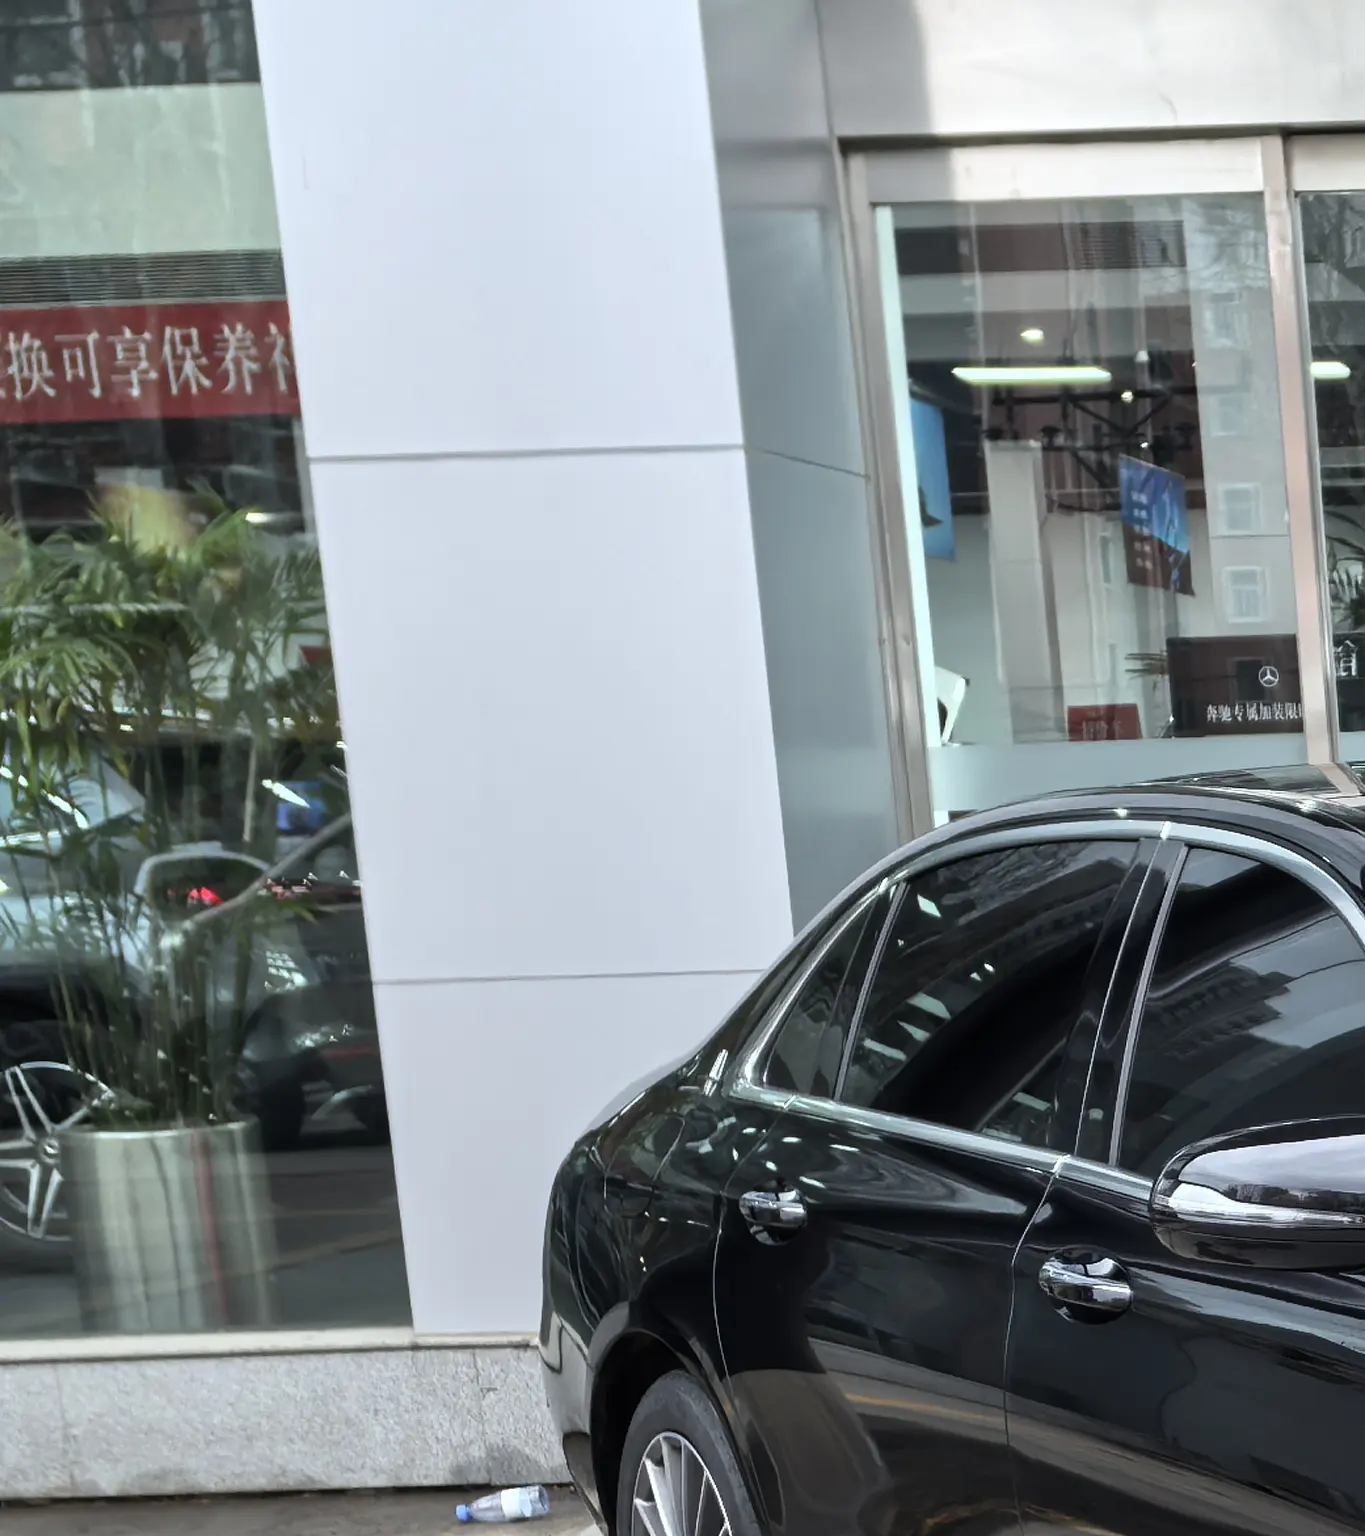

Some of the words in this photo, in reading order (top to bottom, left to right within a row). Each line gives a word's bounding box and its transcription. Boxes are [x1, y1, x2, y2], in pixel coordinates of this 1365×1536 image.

[0, 321, 290, 400] 换可享保养
[1206, 702, 1304, 723] 奔驰专属加装限
